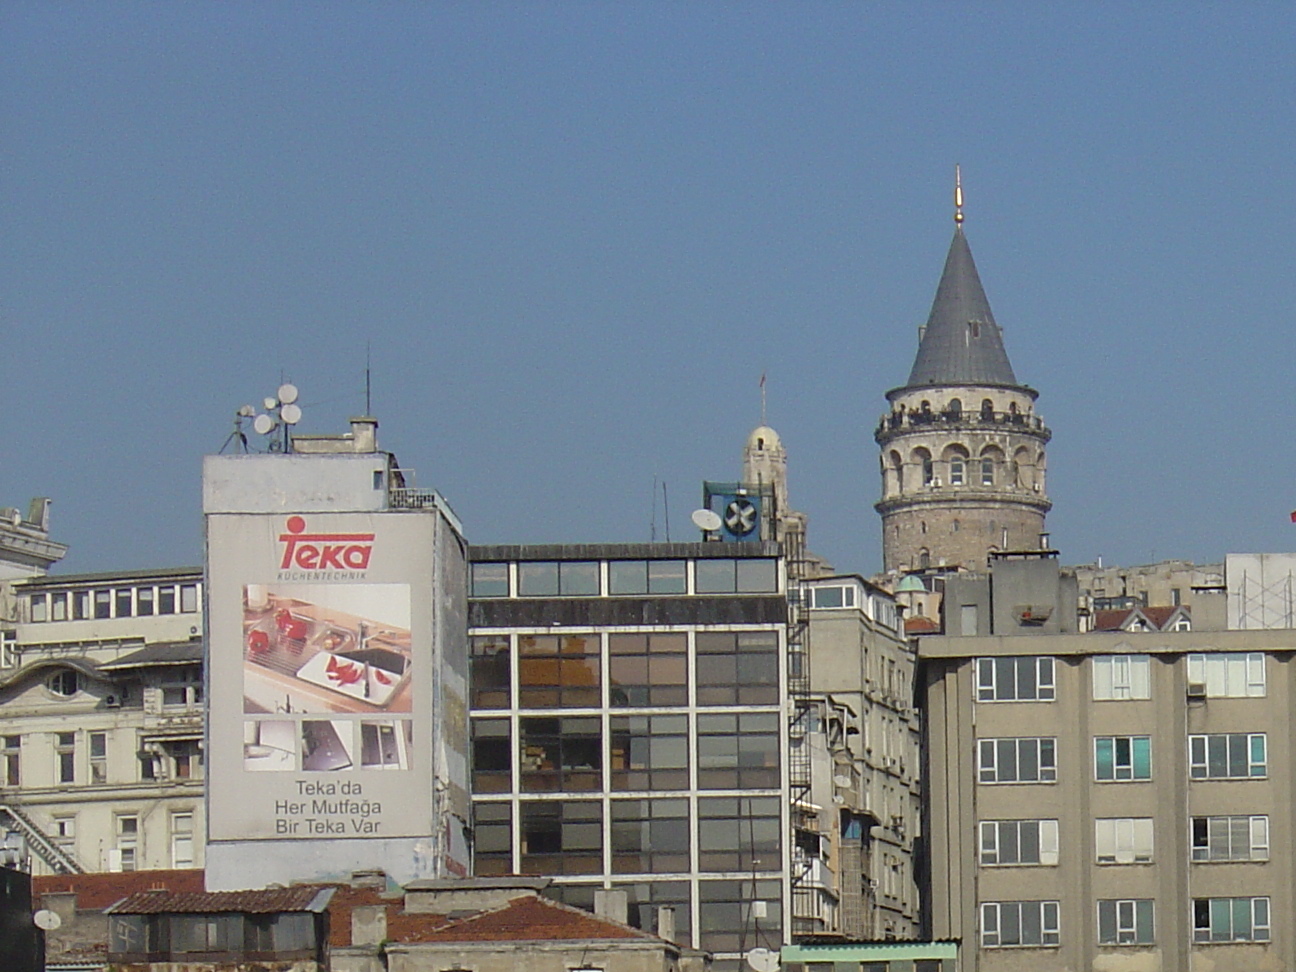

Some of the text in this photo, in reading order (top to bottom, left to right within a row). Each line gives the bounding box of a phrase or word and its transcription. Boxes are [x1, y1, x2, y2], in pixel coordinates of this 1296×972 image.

[295, 780, 362, 795] Teka'da
[275, 800, 382, 818] Her Mutfağa
[276, 818, 381, 834] Bir Teka Var
